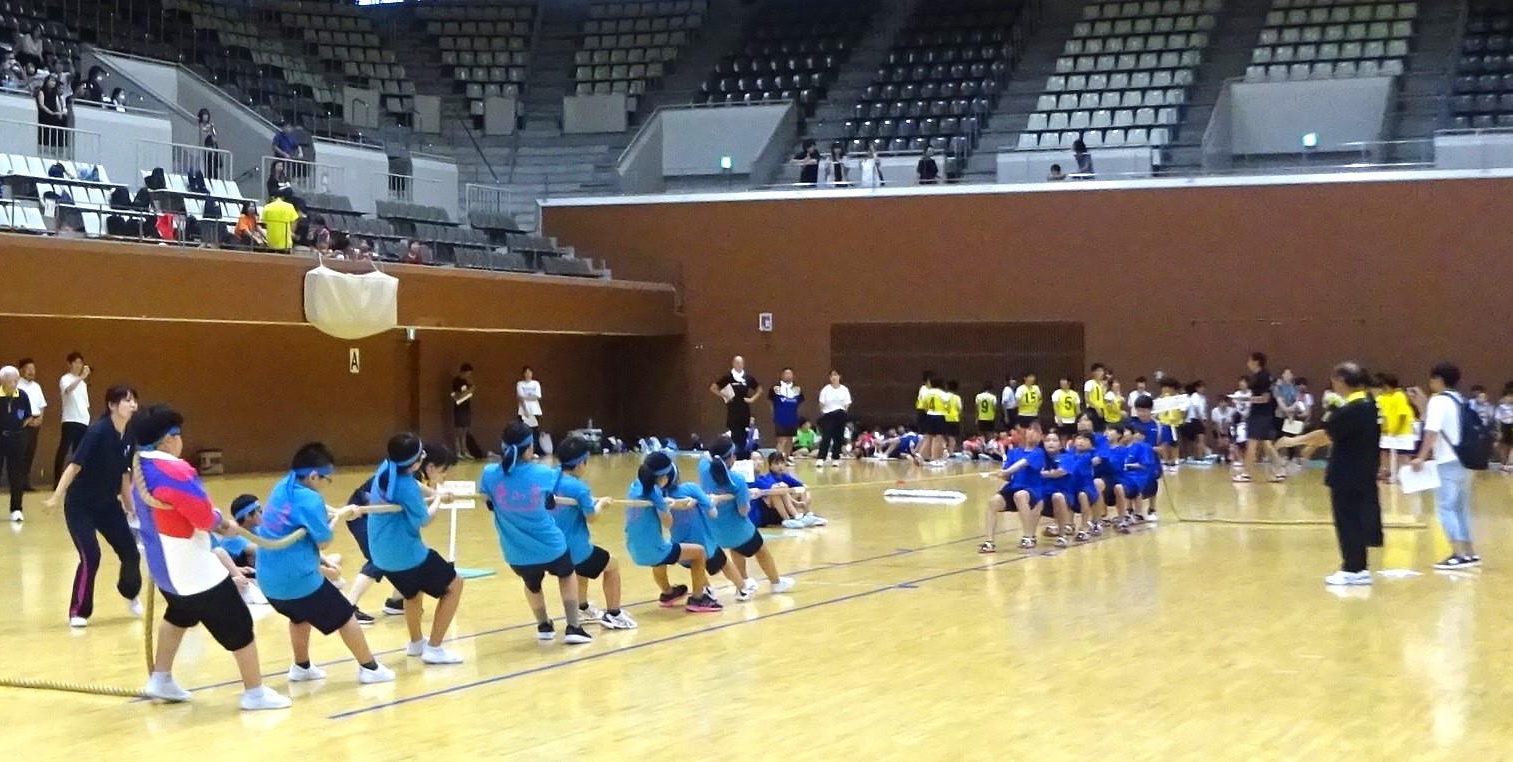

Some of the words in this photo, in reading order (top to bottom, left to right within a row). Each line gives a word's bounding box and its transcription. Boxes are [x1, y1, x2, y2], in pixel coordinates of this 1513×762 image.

[351, 352, 358, 370] A
[981, 399, 989, 413] 9
[1064, 396, 1073, 411] 5
